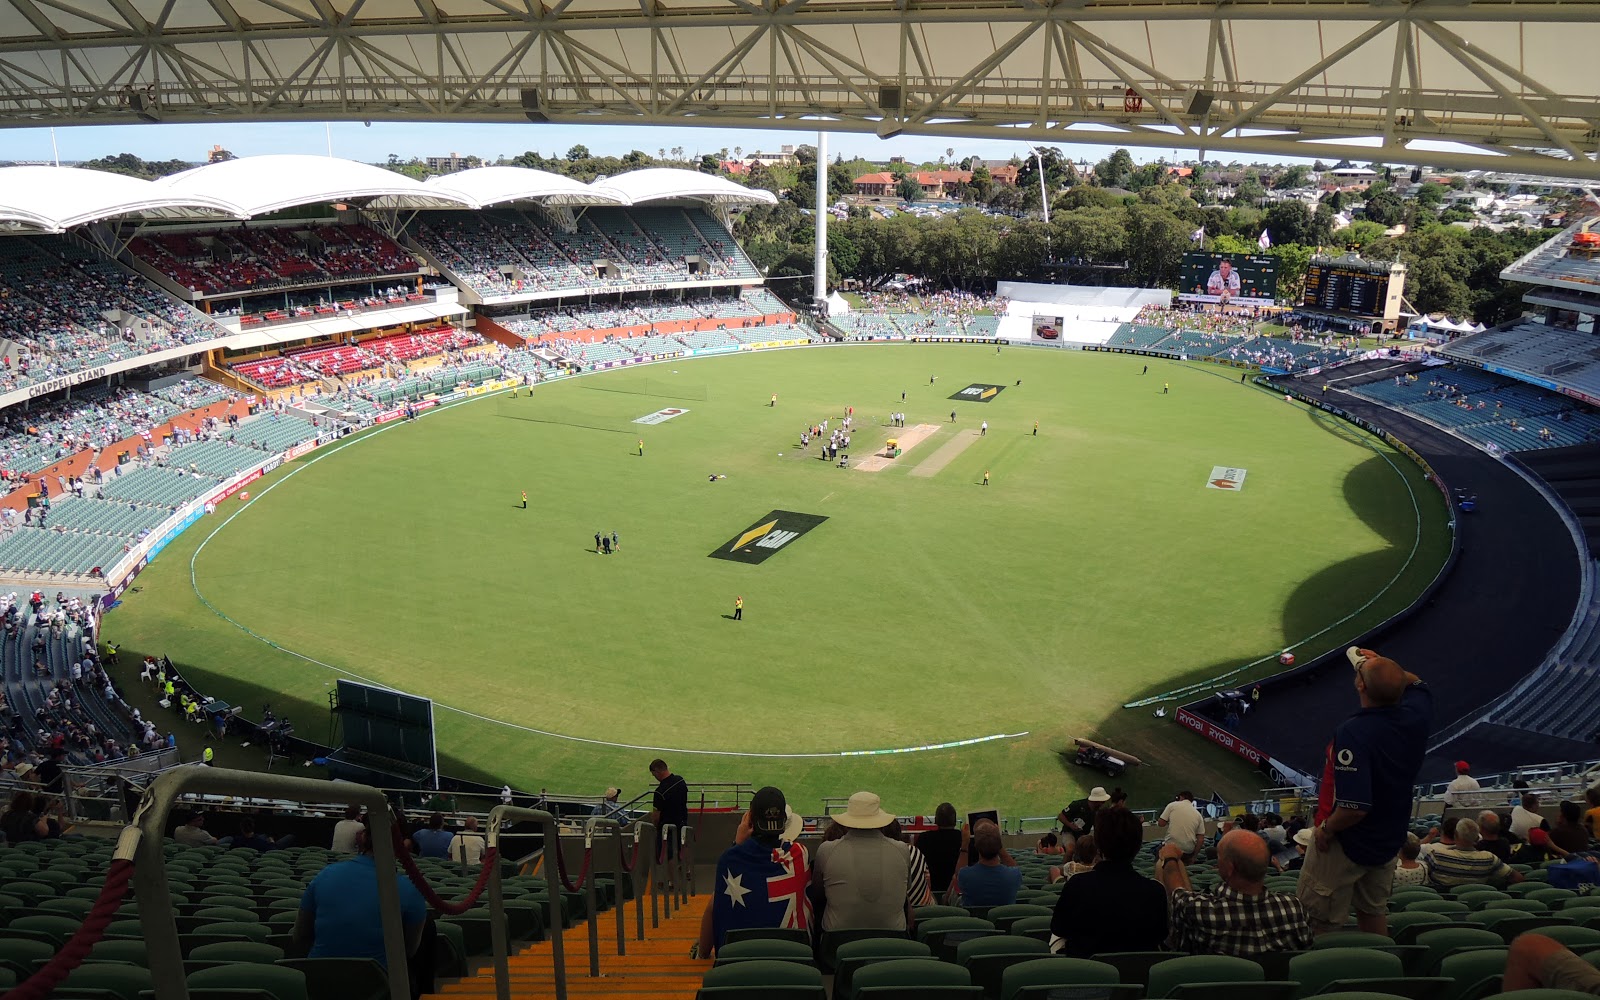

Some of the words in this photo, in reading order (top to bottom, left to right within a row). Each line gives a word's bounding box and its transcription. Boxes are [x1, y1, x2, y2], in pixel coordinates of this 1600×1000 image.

[251, 284, 263, 292] SIR
[267, 280, 298, 290] DONALD
[303, 277, 340, 285] BRADMAN
[344, 272, 378, 281] PAVILION
[28, 376, 74, 398] CHAPPELL
[77, 368, 106, 383] STAND
[292, 442, 314, 456] GATORADE
[262, 460, 280, 474] HARDY
[212, 494, 226, 505] TOYOTA
[756, 530, 800, 549] CAN
[1180, 712, 1203, 732] RYOBI
[1209, 728, 1233, 747] RYOBI
